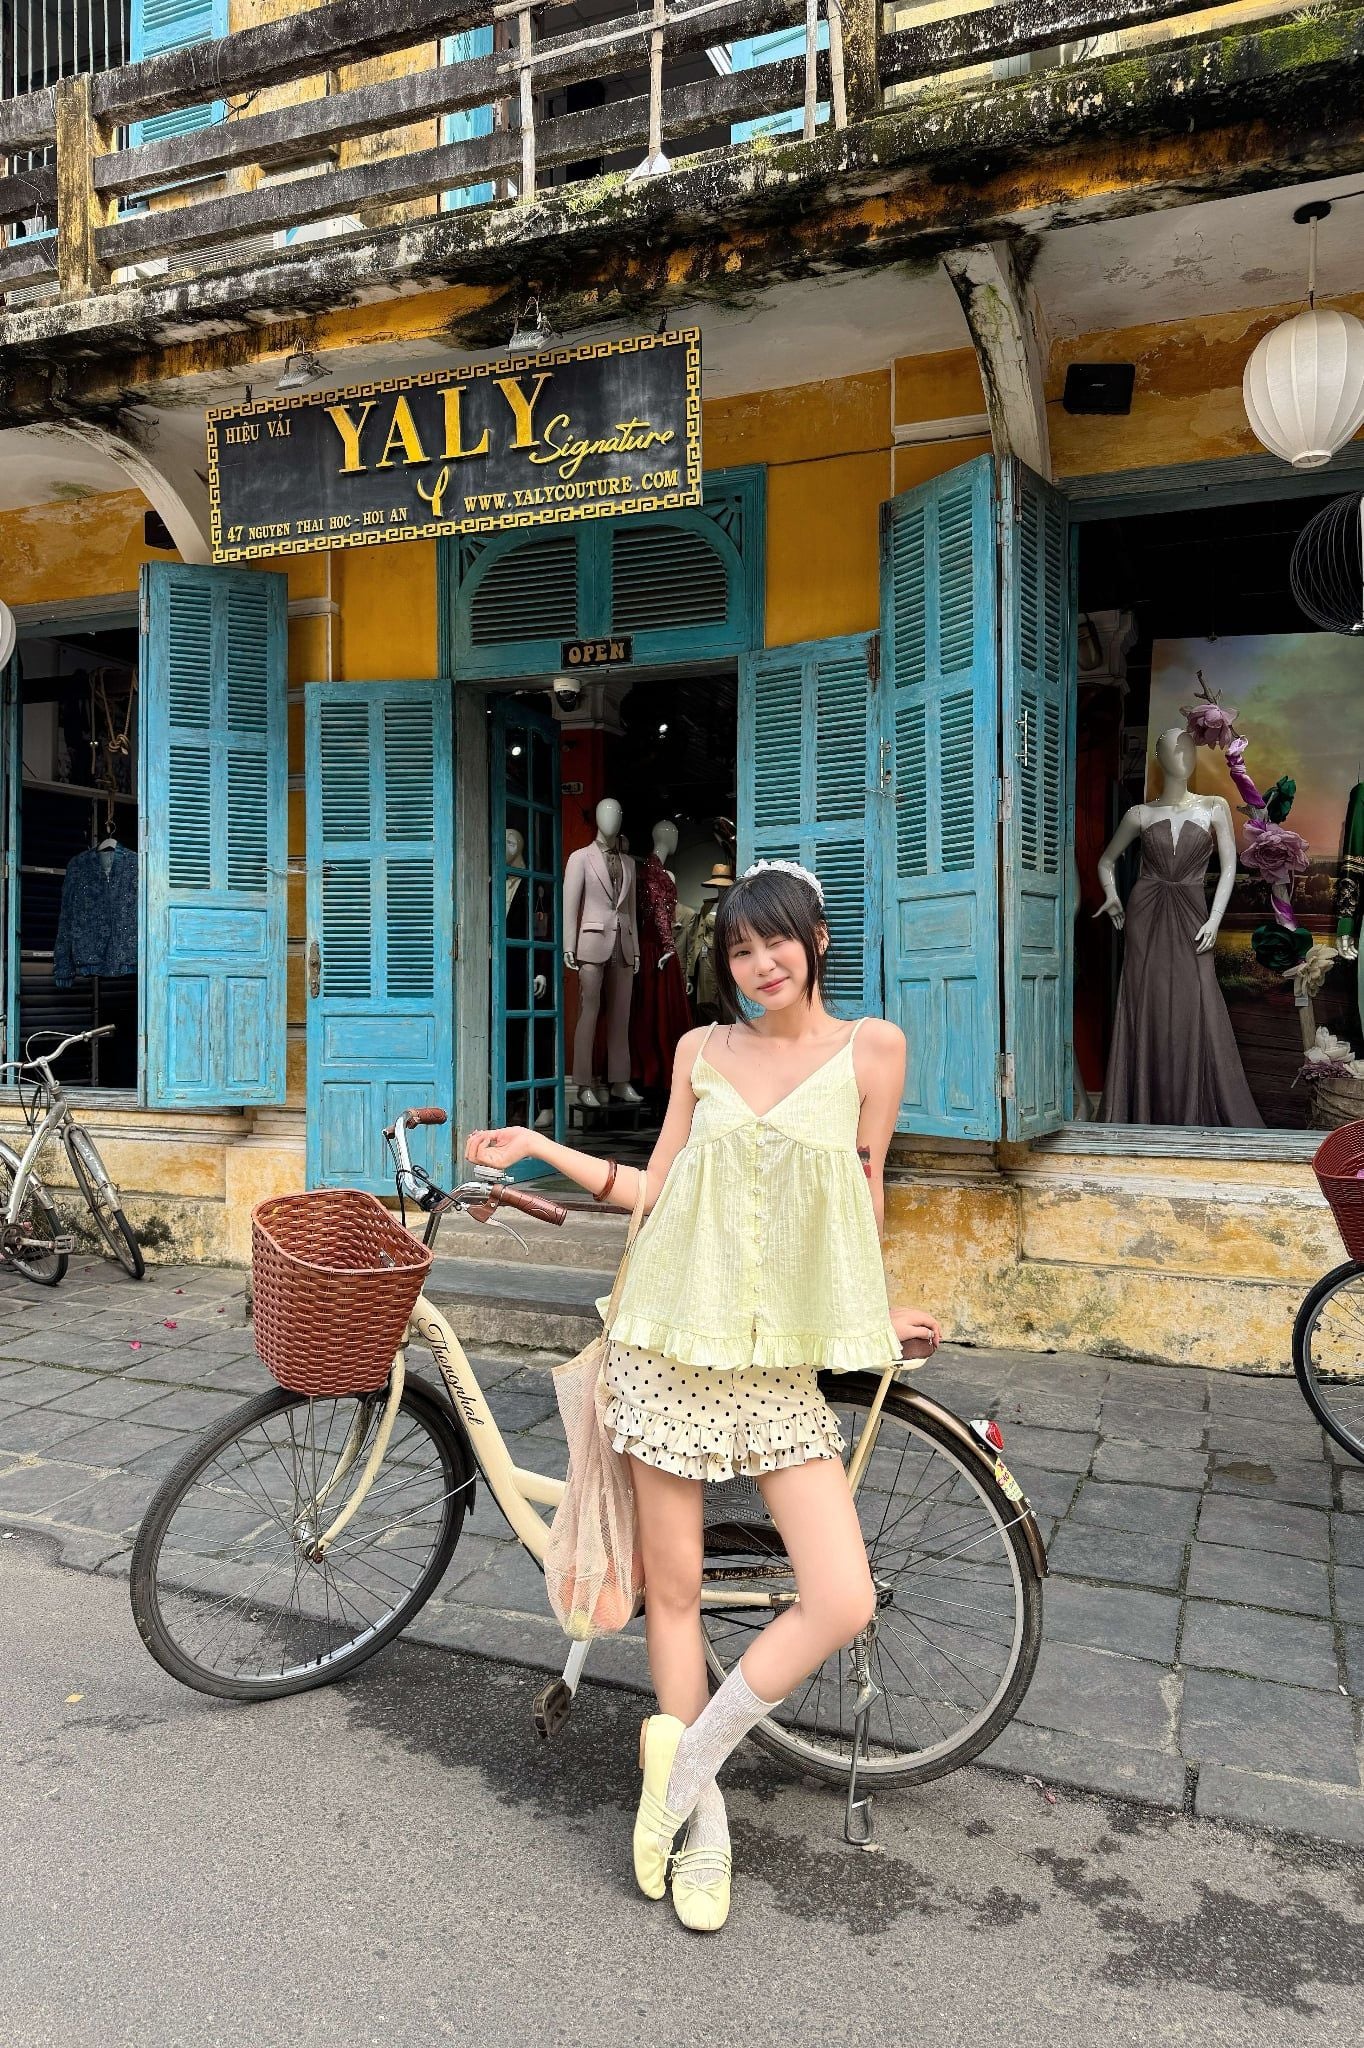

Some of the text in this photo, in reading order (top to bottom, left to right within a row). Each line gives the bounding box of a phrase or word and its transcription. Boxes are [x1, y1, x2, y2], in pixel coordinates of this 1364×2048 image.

[225, 413, 292, 445] HIỆU VẢI
[323, 372, 554, 474] YALY
[528, 413, 675, 480] Signature
[227, 525, 244, 543] 47
[248, 522, 291, 540] NGUYEN
[296, 518, 324, 534] THAI
[389, 507, 408, 522] AN
[568, 642, 625, 664] OPEN
